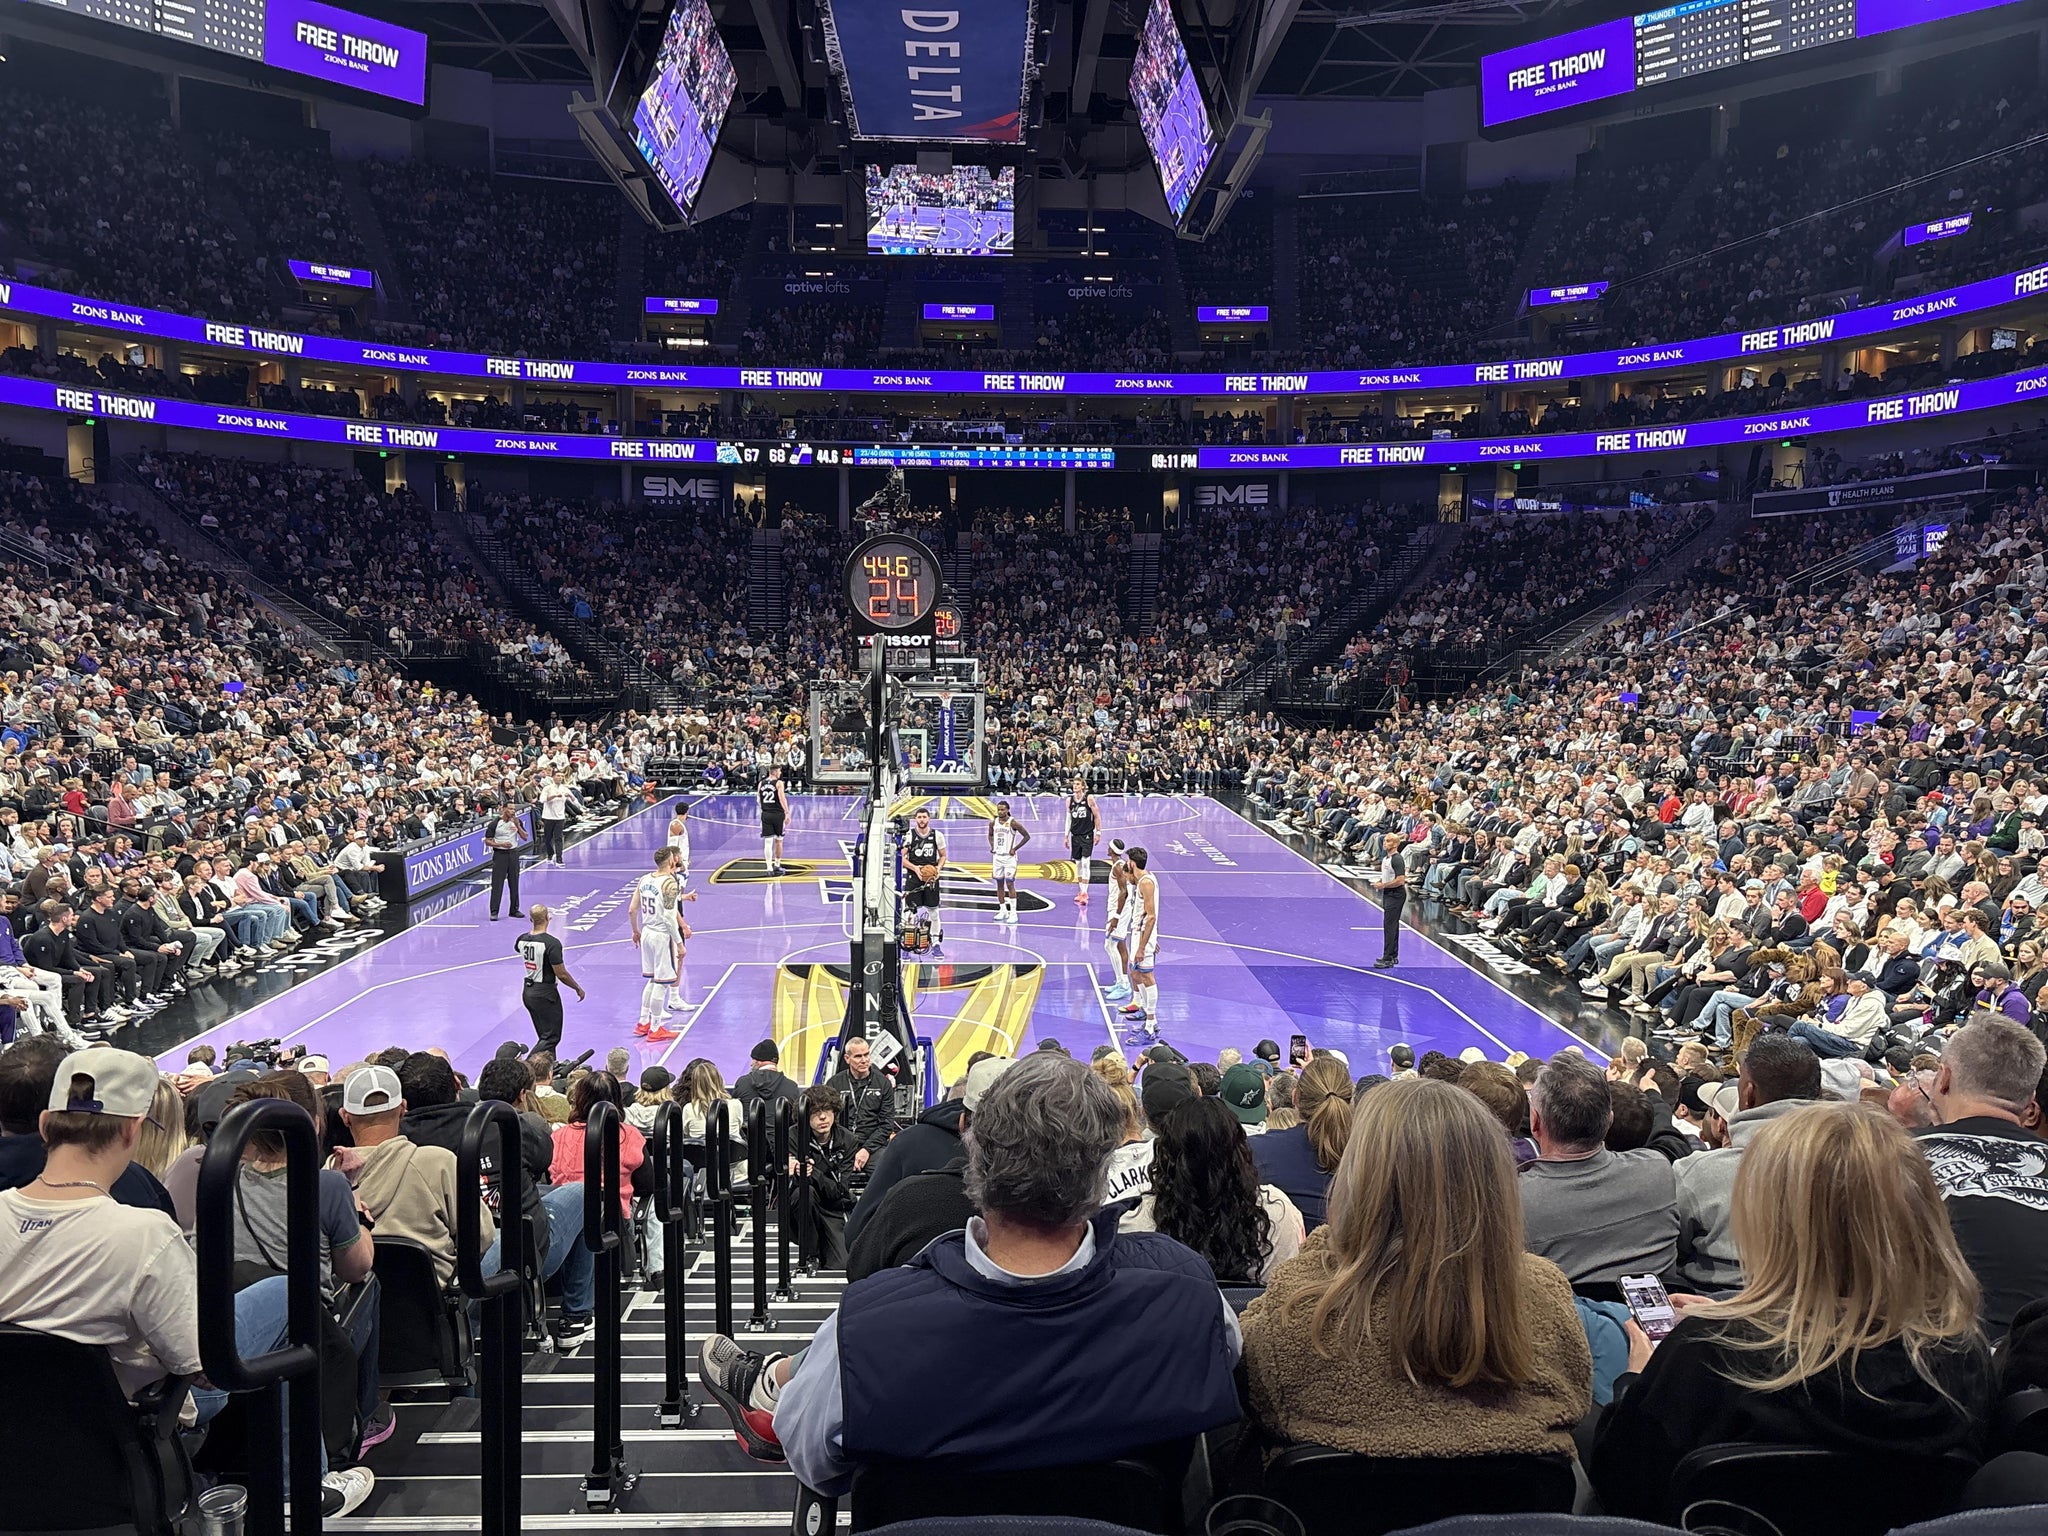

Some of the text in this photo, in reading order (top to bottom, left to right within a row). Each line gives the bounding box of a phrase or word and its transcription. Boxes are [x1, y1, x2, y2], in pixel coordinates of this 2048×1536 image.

[1647, 8, 1676, 22] THUNDER
[297, 22, 337, 51] FREE
[341, 34, 399, 68] THROW
[324, 53, 370, 73] ZIONS BANK
[901, 9, 962, 120] DELTA
[1509, 49, 1605, 91] FREE THROW
[1535, 80, 1577, 96] ZIONS BANK
[784, 280, 850, 295] aptive lofts
[2015, 267, 2048, 295] FREE
[1068, 284, 1133, 300] aptive lofts
[72, 303, 144, 325] ZIONS BANK
[1893, 297, 1956, 320] ZIONS BANK
[206, 324, 303, 353] FREE THROW
[1742, 319, 1834, 352] FREE THROW
[363, 349, 429, 365] ZIONS BANK
[1618, 349, 1683, 365] ZIONS BANK
[487, 359, 574, 379] FREE THROW
[627, 371, 688, 380] ZIONS BANK
[1476, 360, 1563, 381] FREE THROW
[741, 371, 822, 387] FREE THROW
[874, 376, 931, 385] ZIONS BANK
[984, 375, 1065, 390] FREE THROW
[1115, 380, 1172, 388] ZIONS BANK
[1226, 376, 1307, 391] FREE THROW
[1360, 374, 1420, 384] ZIONS BANK
[2016, 377, 2046, 392] ZIONS
[57, 388, 155, 419] FREE THROW
[1868, 390, 1959, 422] FREE THROW
[218, 414, 288, 430] ZIONS BANK
[1744, 417, 1810, 433] ZIONS BANK
[347, 425, 438, 447] FREE THROW
[1597, 429, 1686, 451] FREE THROW
[496, 439, 558, 450] ZIONS BANK
[611, 442, 695, 459] FREE THROW
[1480, 444, 1542, 455] ZIONS BANK
[744, 448, 759, 462] 67
[769, 449, 785, 462] 68
[817, 450, 838, 463] 44.6
[1151, 454, 1197, 468] 09:11 PM
[1230, 454, 1259, 462] ZIONS
[1341, 447, 1425, 463] FREE THROW
[643, 476, 720, 498] SME
[1194, 484, 1268, 505] SME
[1842, 486, 1895, 499] HEALTH PLANS
[863, 556, 909, 577] 44.6
[868, 579, 918, 617] 24
[935, 620, 955, 635] 24
[762, 791, 776, 804] 22
[1078, 810, 1087, 818] 23
[923, 848, 933, 857] 30
[410, 855, 444, 886] ZIONS
[444, 843, 473, 872] BANK
[641, 896, 656, 915] 55
[523, 945, 535, 961] 30
